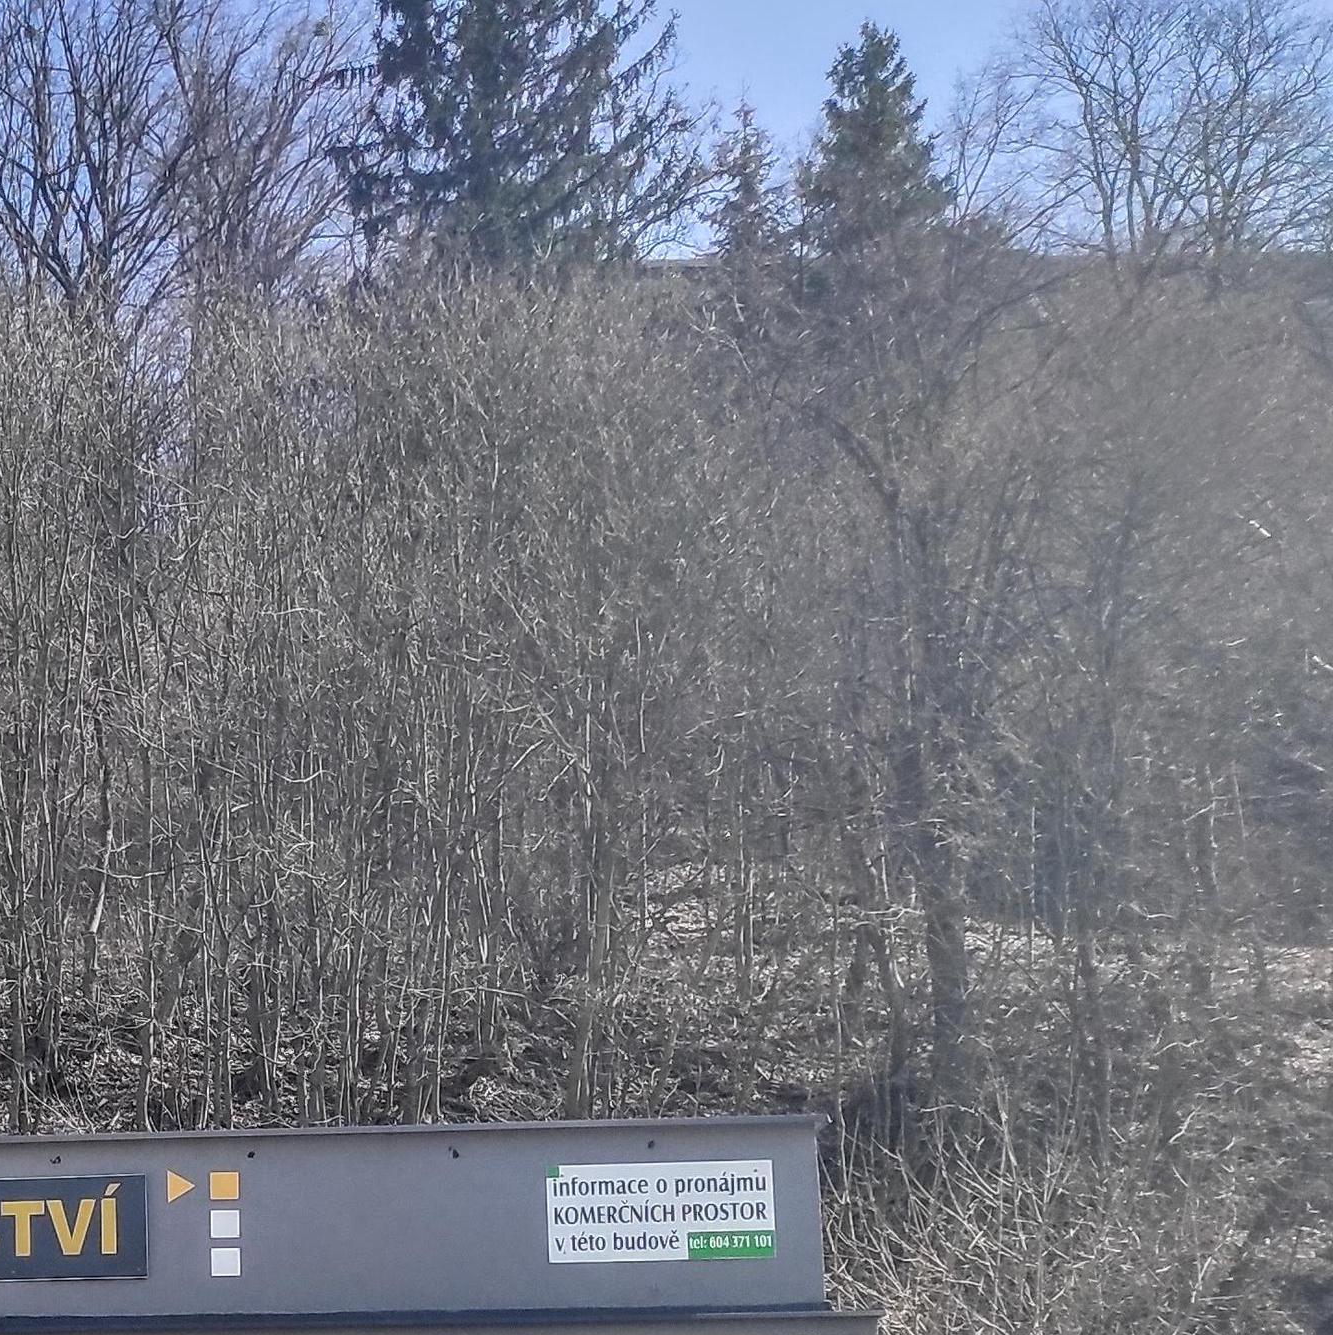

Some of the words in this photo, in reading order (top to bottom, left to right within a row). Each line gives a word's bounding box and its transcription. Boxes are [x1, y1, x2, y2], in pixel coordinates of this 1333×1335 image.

[553, 1174, 649, 1198] informace
[655, 1178, 668, 1194] o
[554, 1200, 676, 1226] KOMERČNÍCH
[681, 1201, 768, 1223] PROSTOR
[555, 1236, 565, 1250] v
[570, 1230, 606, 1251] této
[612, 1229, 680, 1251] budově
[689, 1235, 707, 1250] tel:
